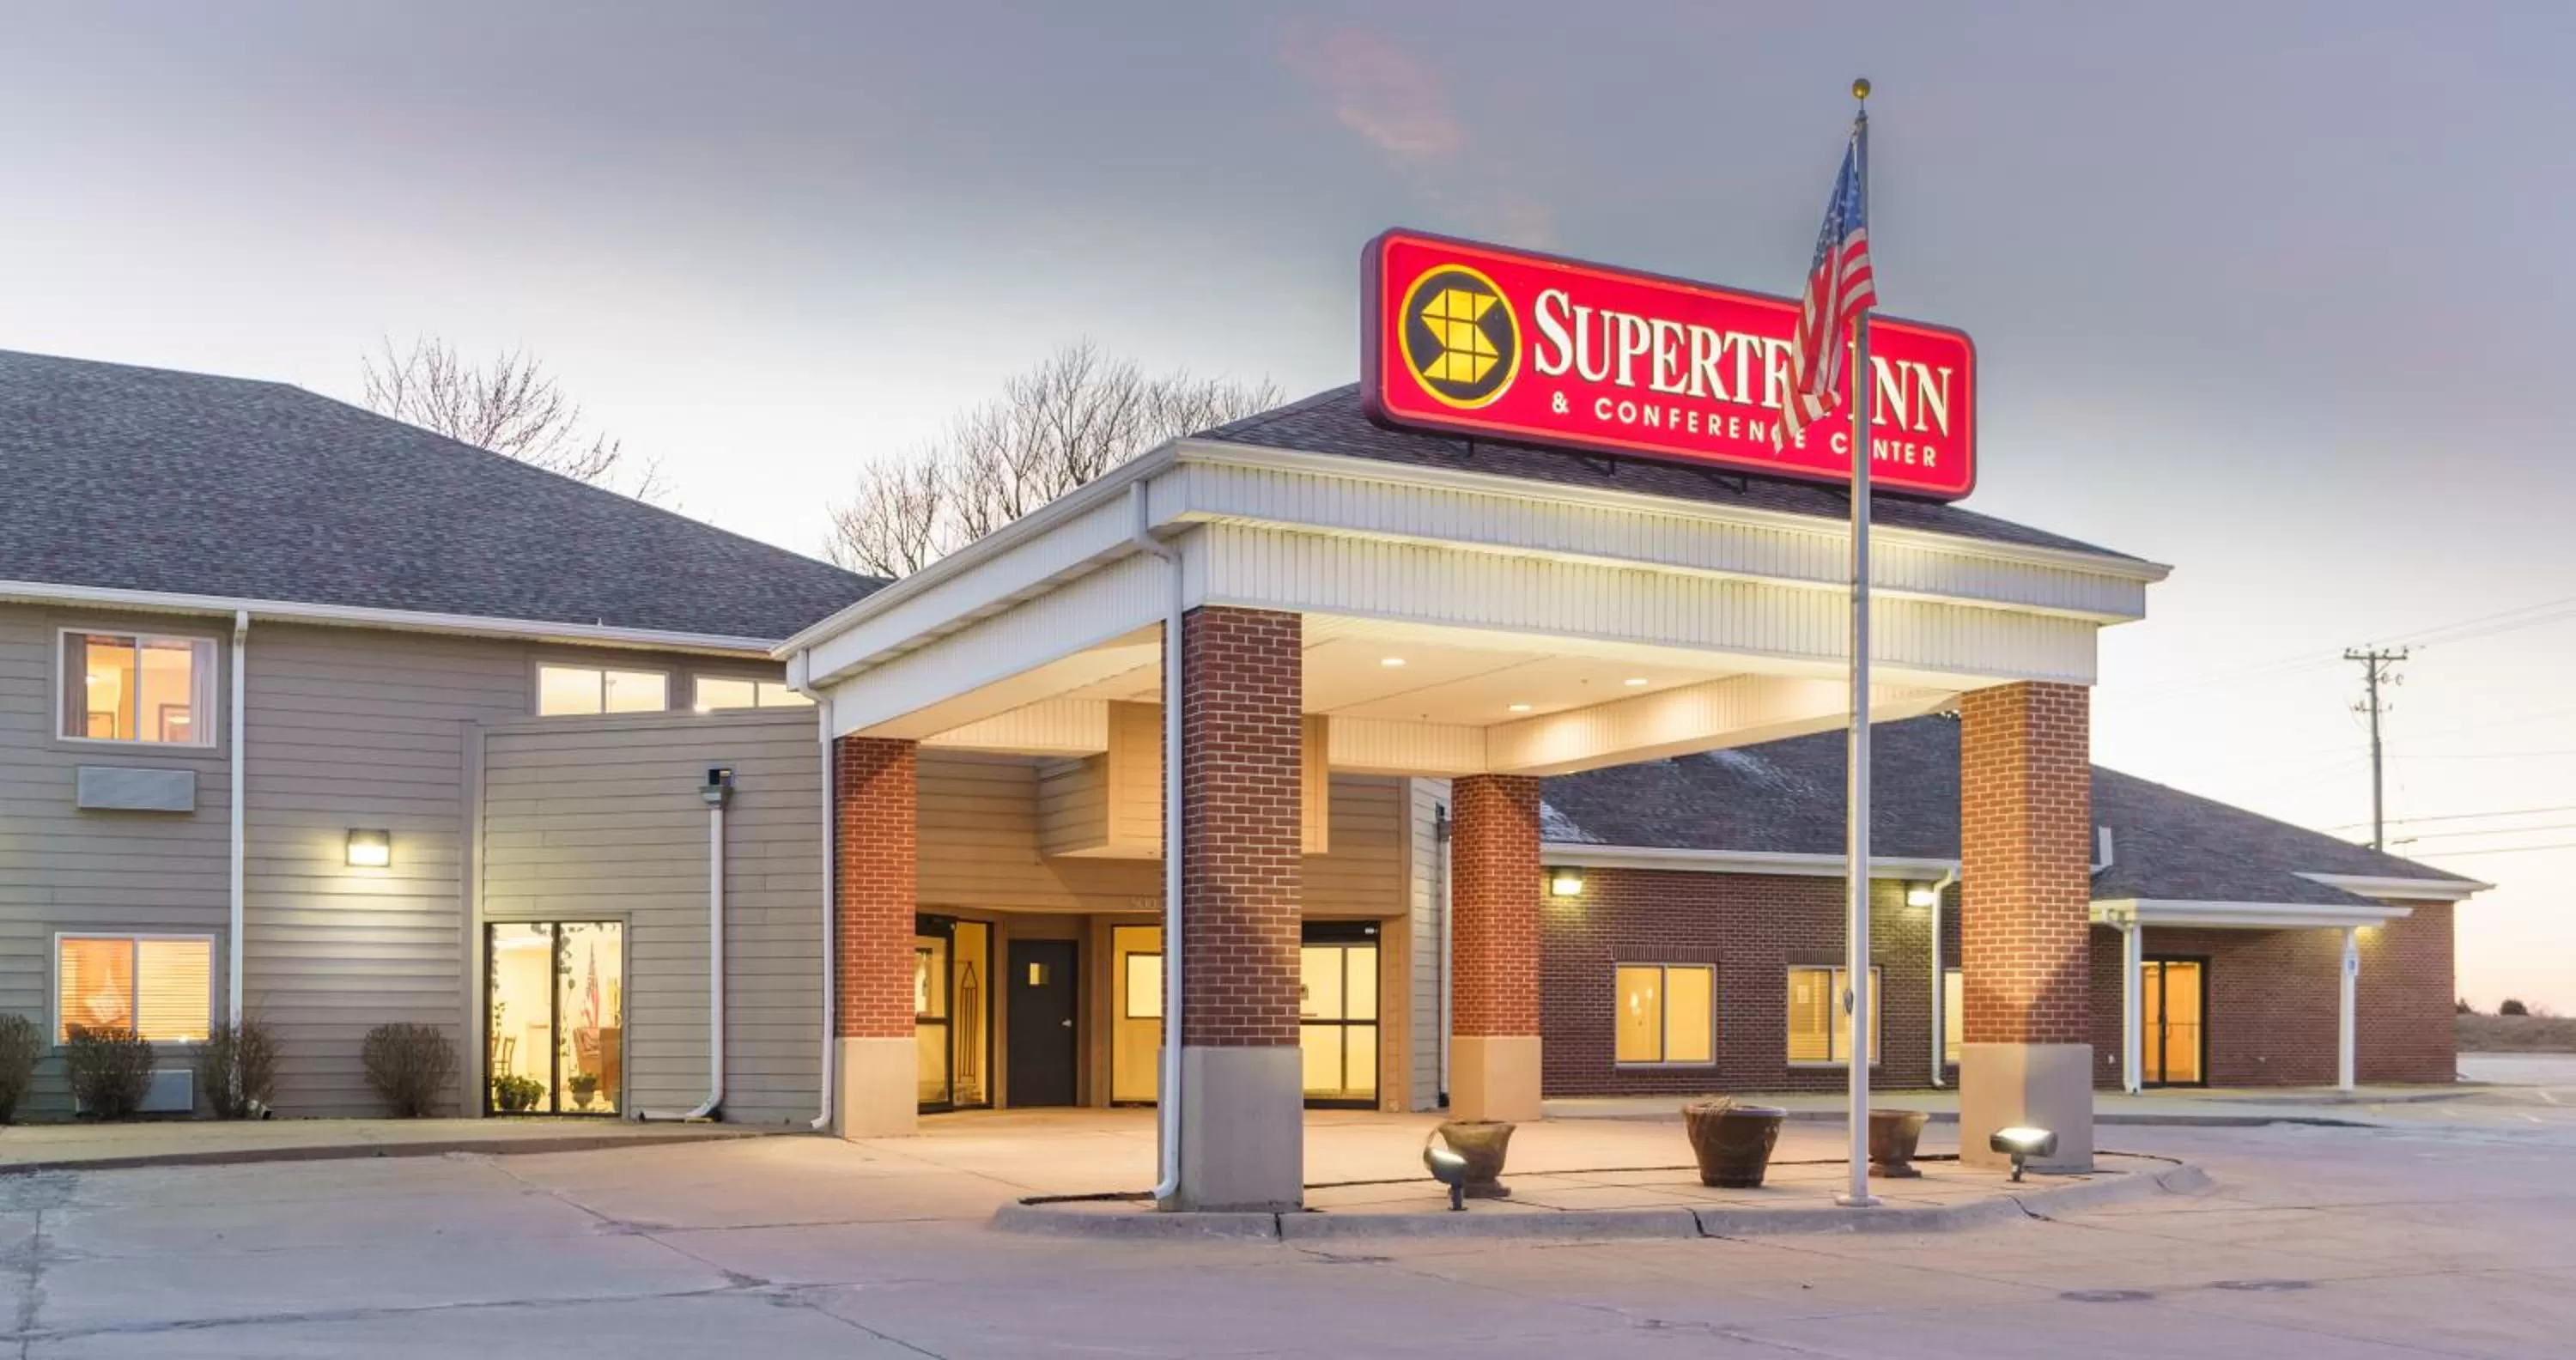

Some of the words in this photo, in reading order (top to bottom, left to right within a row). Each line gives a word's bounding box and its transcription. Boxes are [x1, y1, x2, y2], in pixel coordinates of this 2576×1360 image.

[1534, 288, 1832, 416] SUPERTE
[1551, 391, 1570, 414] &
[1830, 431, 1936, 468] CNTER
